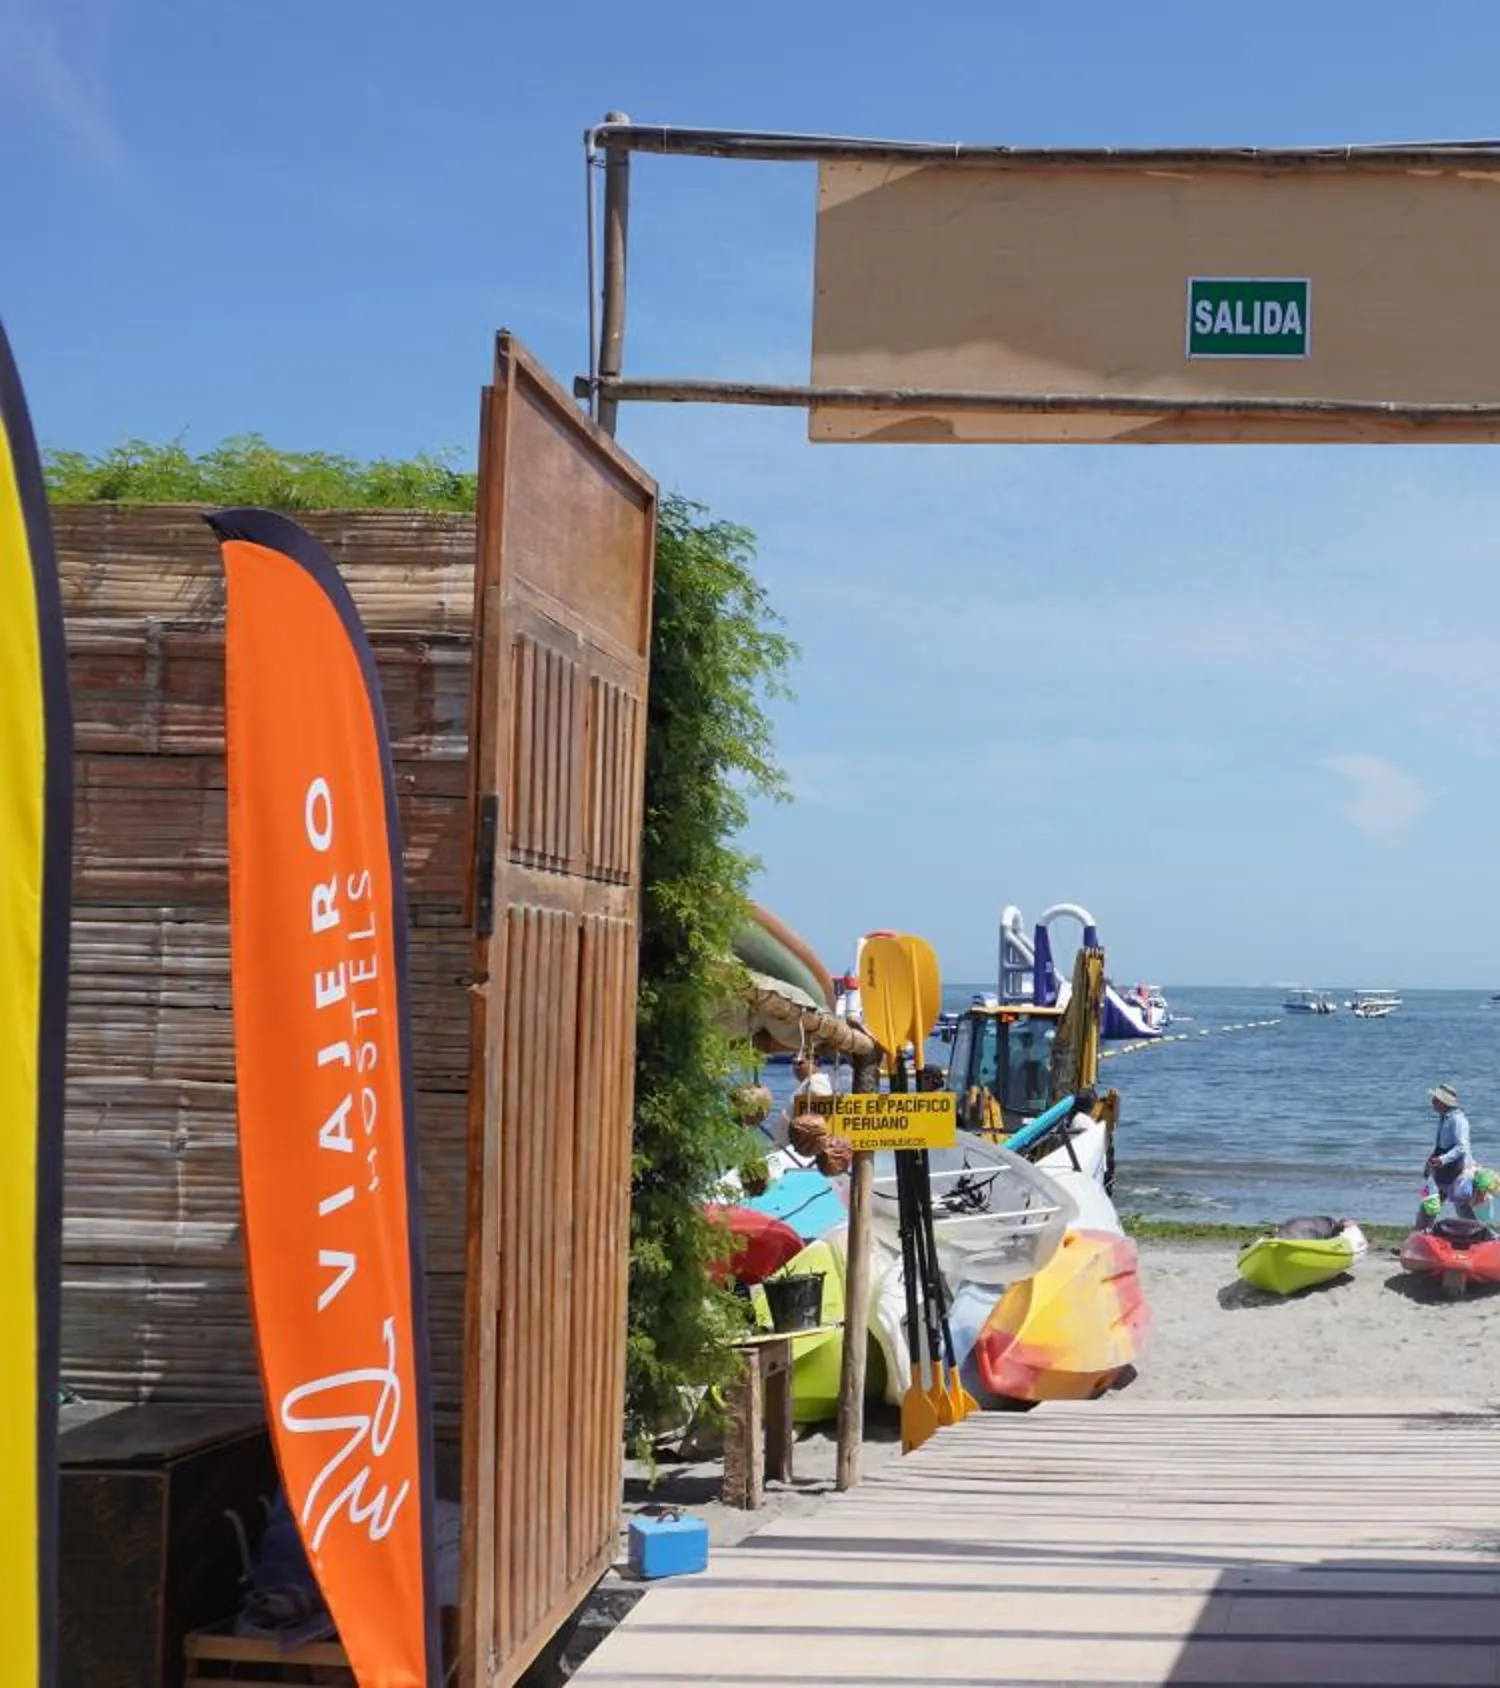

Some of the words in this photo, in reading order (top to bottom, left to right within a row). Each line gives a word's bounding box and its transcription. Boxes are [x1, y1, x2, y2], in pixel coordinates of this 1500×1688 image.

[1195, 299, 1303, 335] SALIDA
[305, 776, 357, 1312] VIAJERO
[799, 1099, 862, 1116] PROTEGE
[866, 1099, 882, 1114] EL
[887, 1097, 950, 1114] PACÍFICO
[842, 1117, 909, 1131] PERUANO
